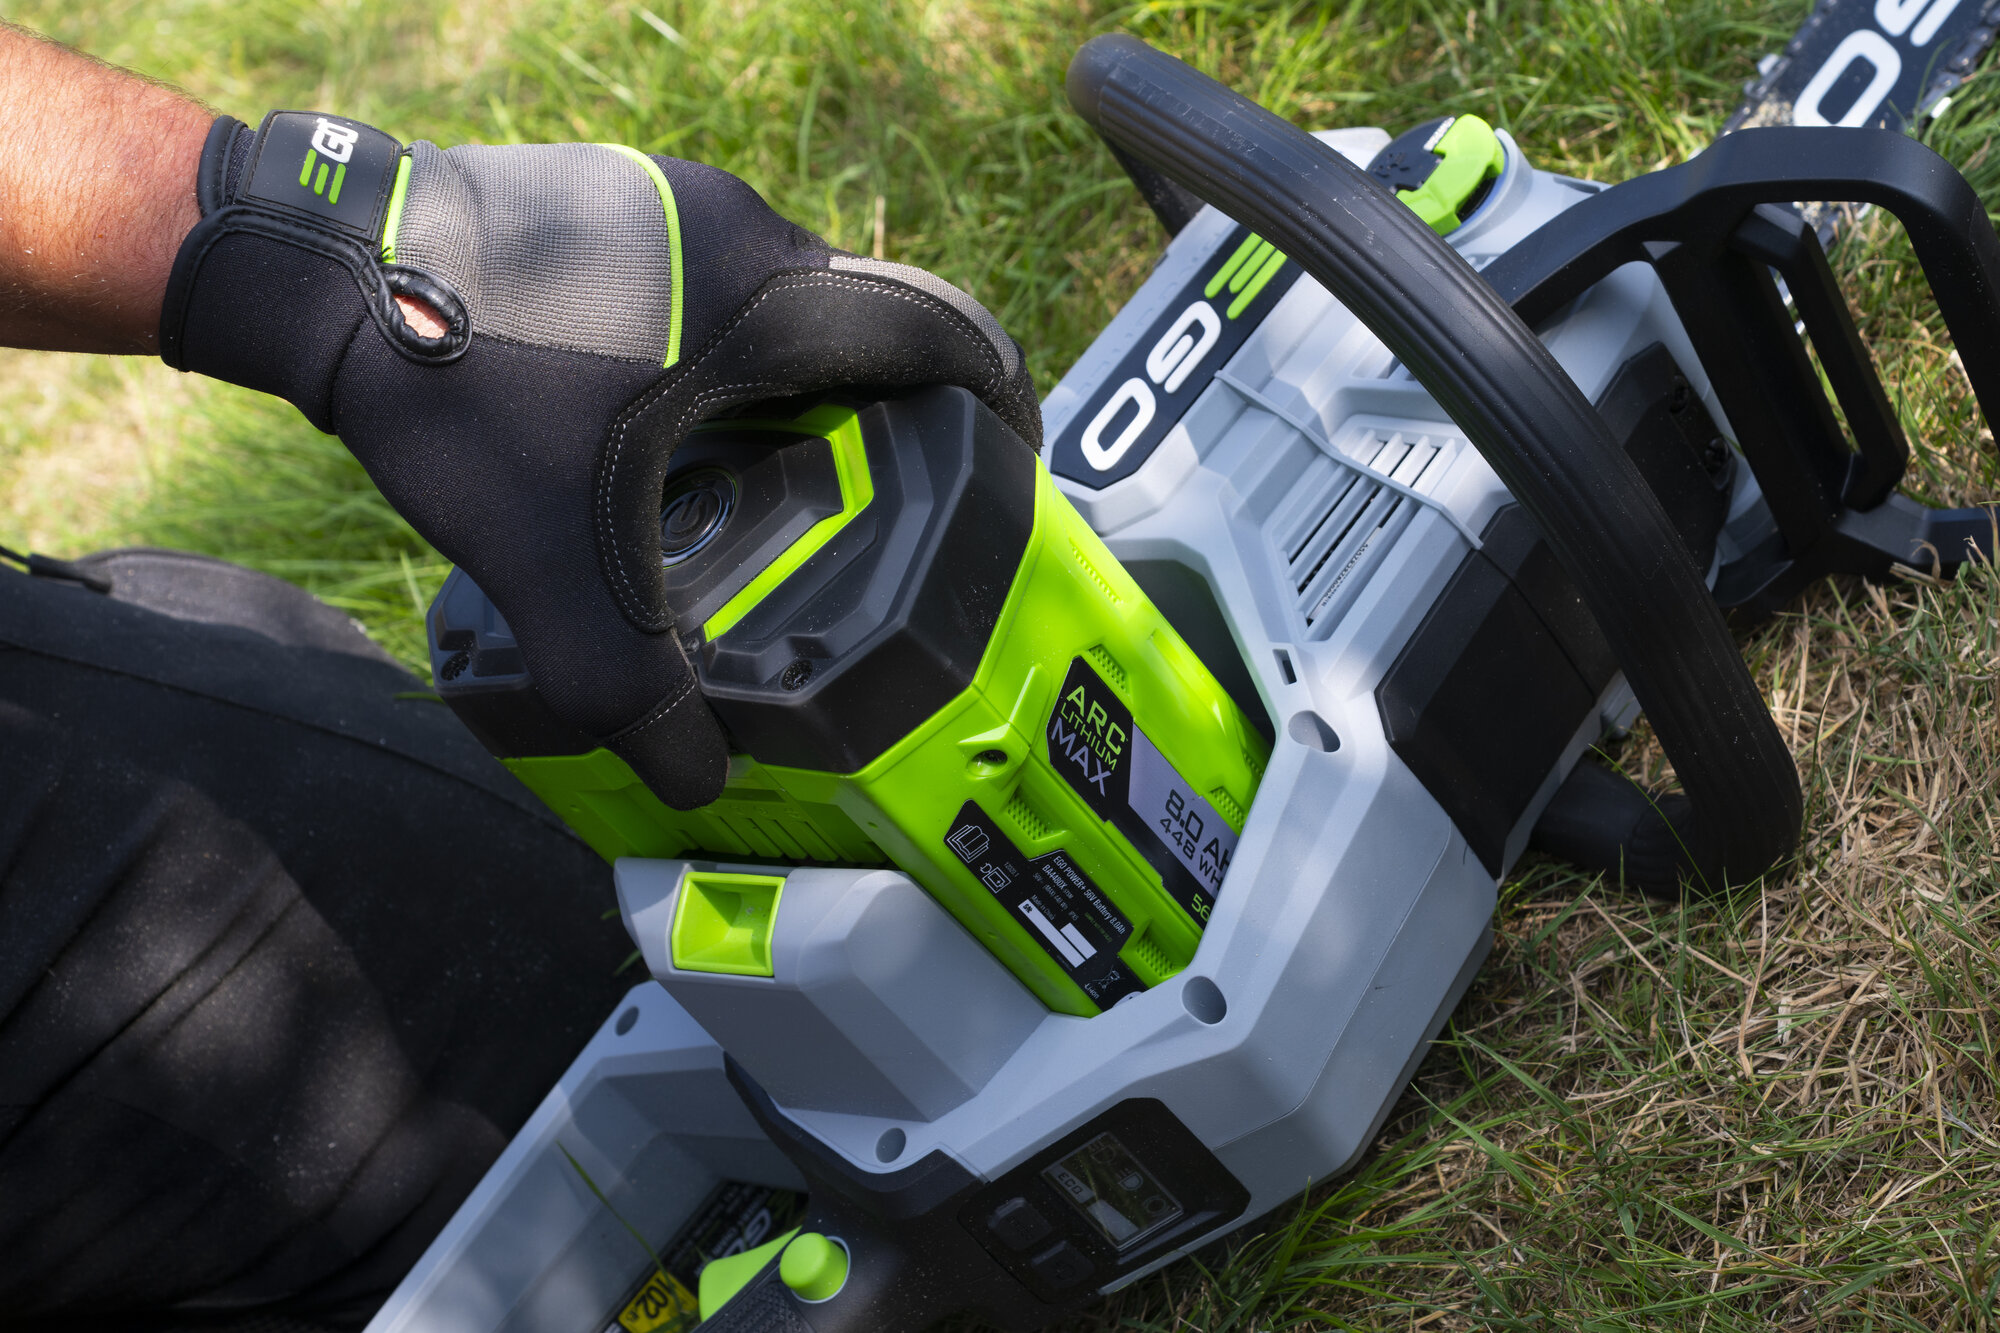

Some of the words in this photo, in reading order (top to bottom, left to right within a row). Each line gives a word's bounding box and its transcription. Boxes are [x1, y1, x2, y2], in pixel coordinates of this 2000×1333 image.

[299, 117, 359, 205] EGO
[1060, 702, 1118, 770] LITHIUM
[1066, 685, 1126, 755] ARC
[1051, 717, 1111, 797] MAX
[1160, 818, 1195, 860] 448
[1165, 789, 1204, 843] 8.0
[1053, 855, 1067, 869] EGO
[1064, 867, 1087, 890] POWER+
[1084, 888, 1096, 901] 56V
[1093, 899, 1112, 920] Battery
[1112, 917, 1125, 933] 8.0Ah
[1058, 1171, 1082, 1194] ECO
